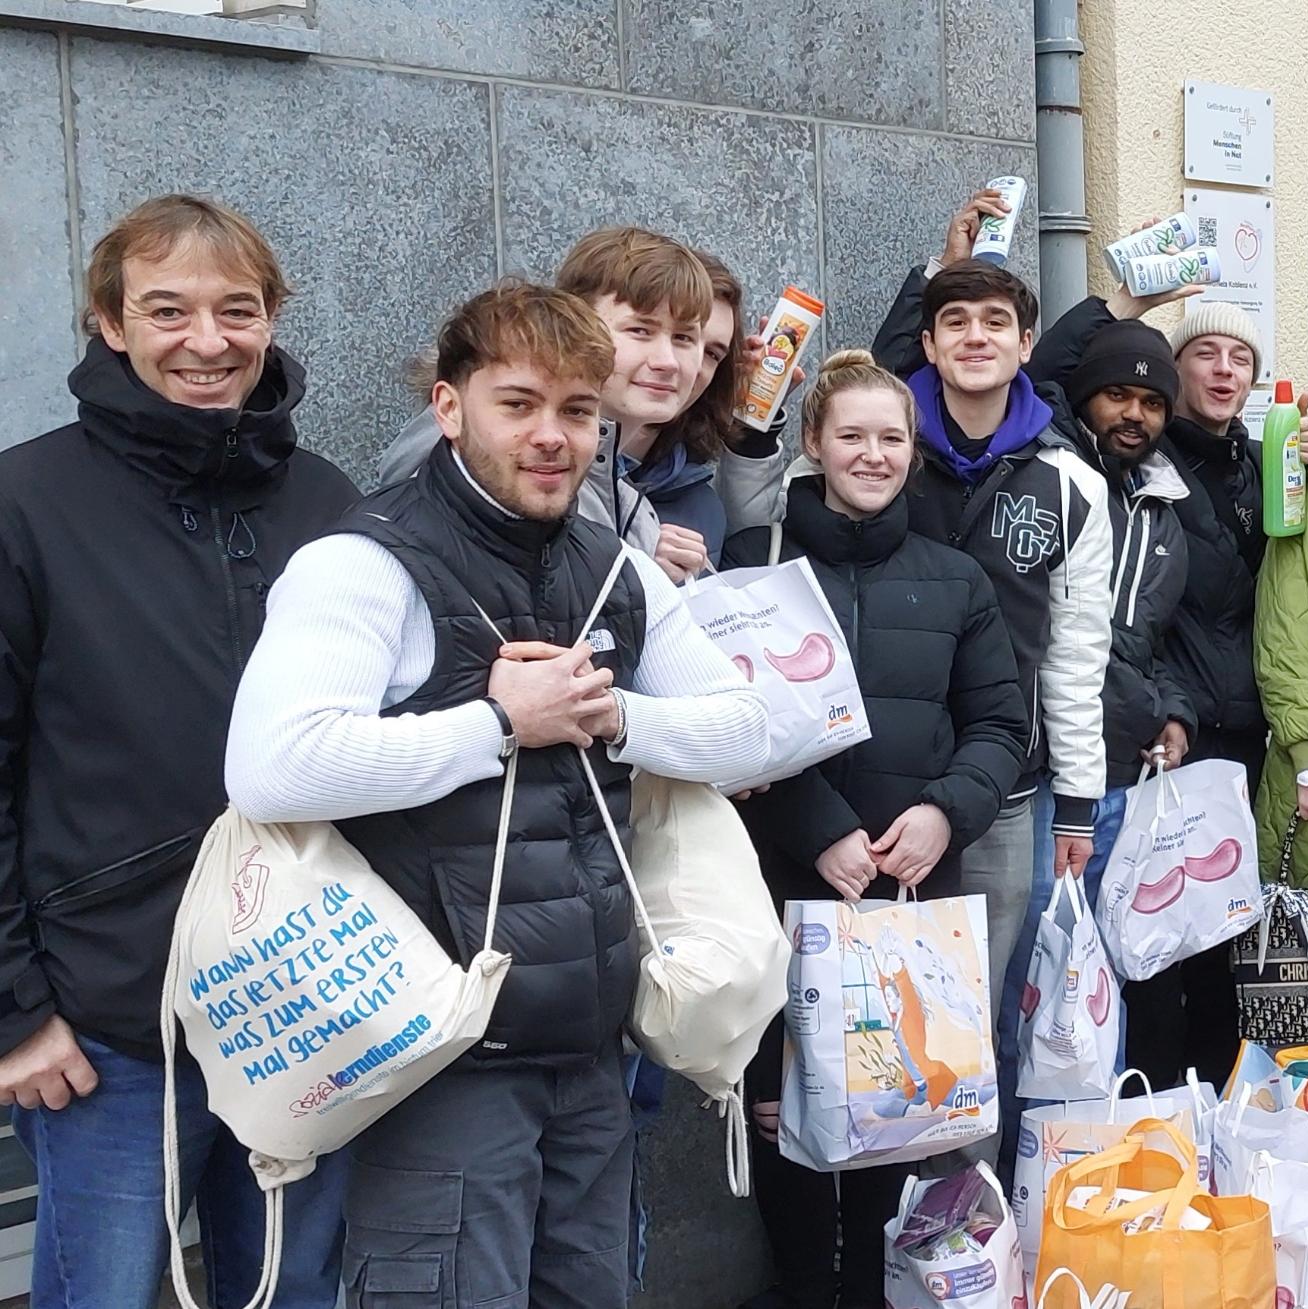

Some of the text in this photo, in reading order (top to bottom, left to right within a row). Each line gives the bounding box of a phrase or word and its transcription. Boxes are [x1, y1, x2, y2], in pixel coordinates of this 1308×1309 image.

[1213, 139, 1242, 149] Menschen
[829, 704, 848, 721] dm
[322, 882, 354, 916] du
[1228, 899, 1247, 912] dm
[955, 1087, 977, 1108] dm
